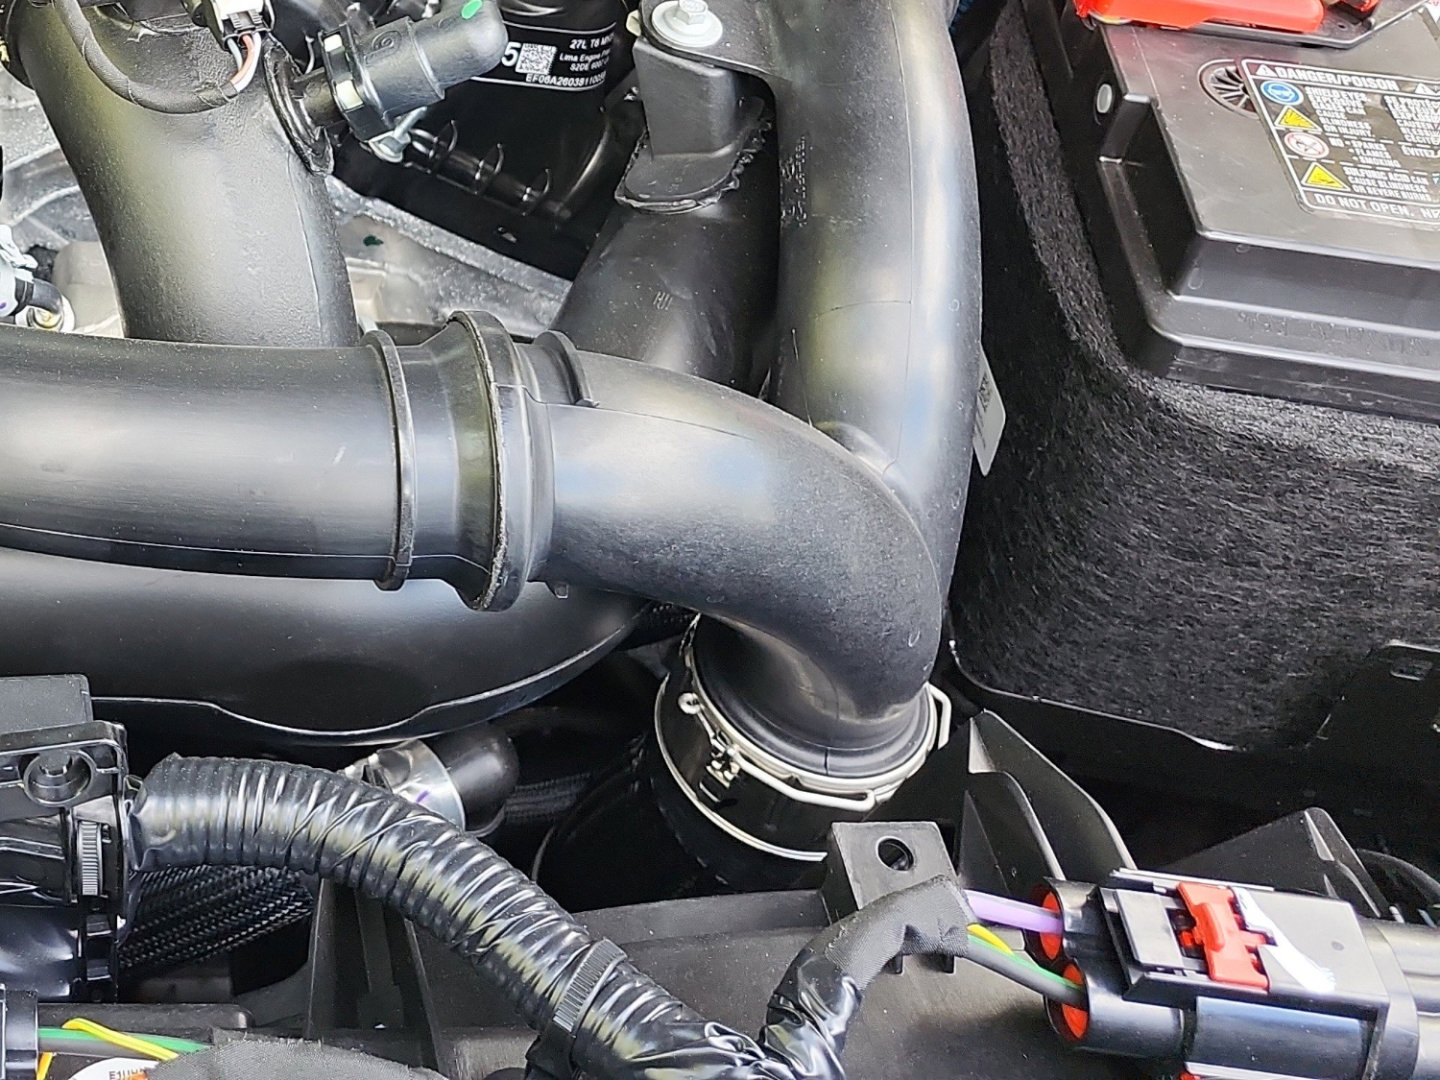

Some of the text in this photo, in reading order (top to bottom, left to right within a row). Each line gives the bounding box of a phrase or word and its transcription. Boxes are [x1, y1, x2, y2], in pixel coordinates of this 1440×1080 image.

[1274, 66, 1400, 91] DANGER/POISON
[1313, 193, 1336, 205] DO
[1337, 196, 1368, 210] NOT
